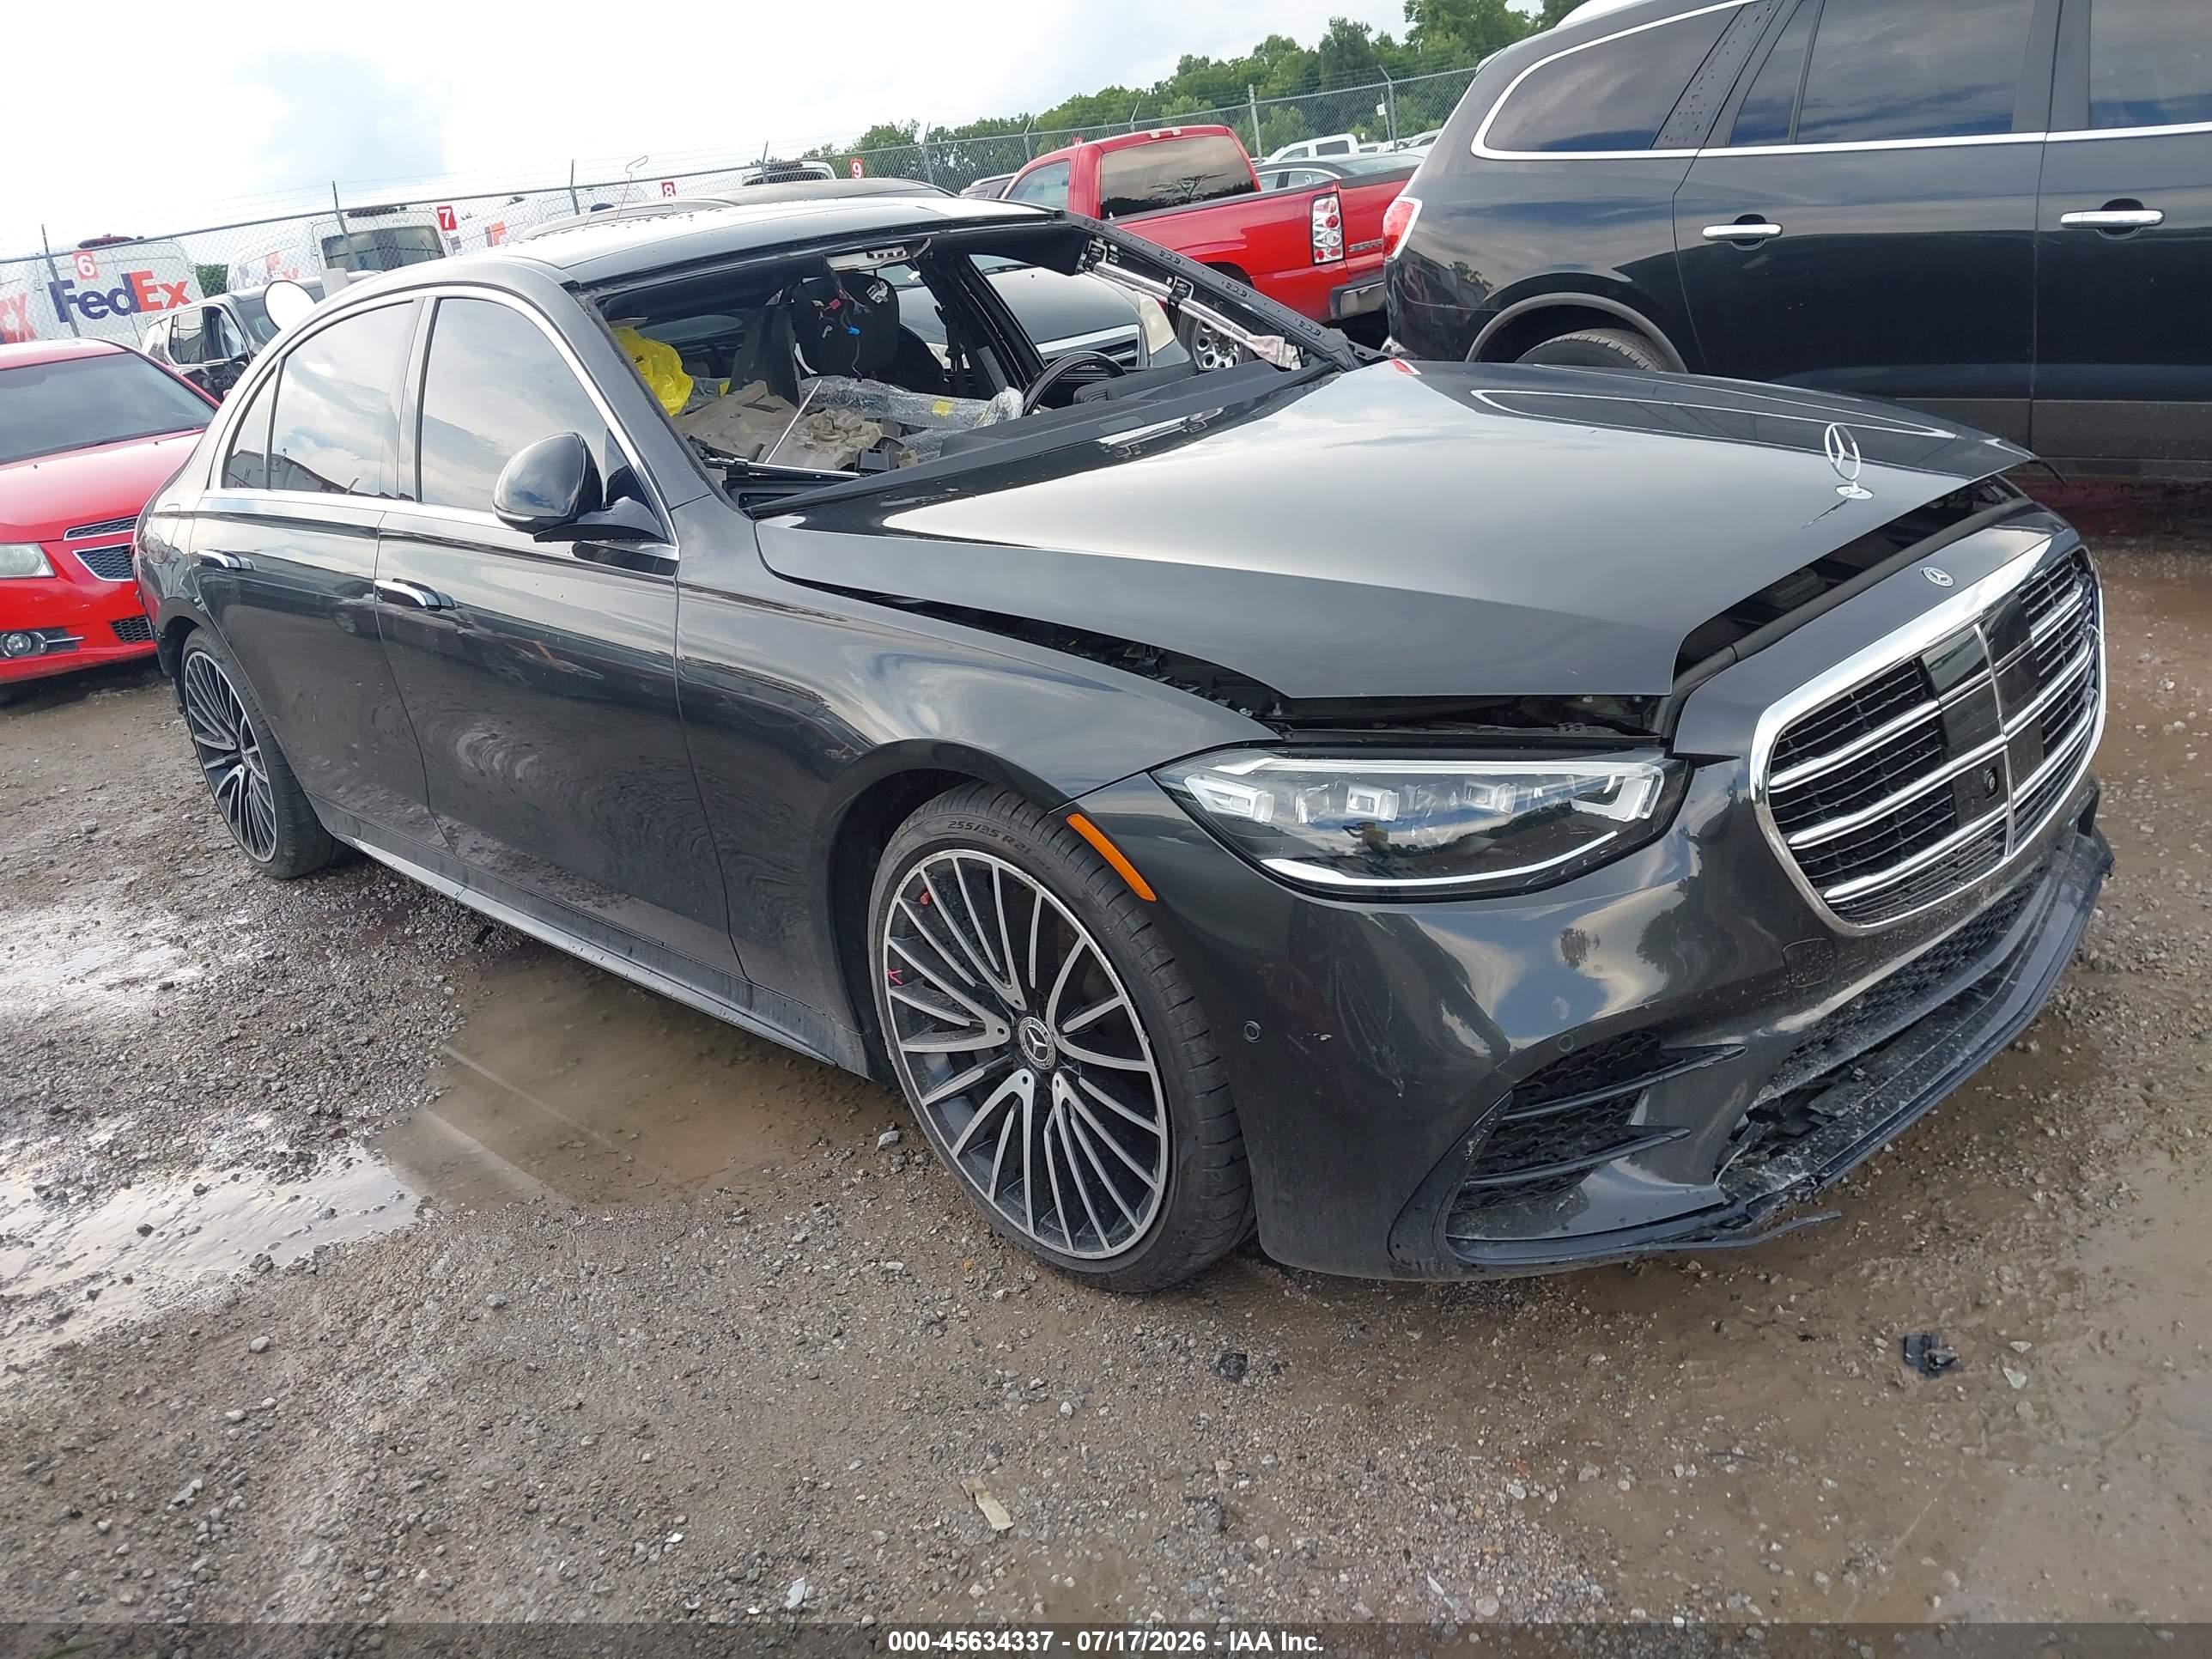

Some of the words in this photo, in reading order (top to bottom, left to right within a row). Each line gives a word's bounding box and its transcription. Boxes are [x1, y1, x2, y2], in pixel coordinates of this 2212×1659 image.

[853, 161, 862, 179] 9
[663, 184, 675, 198] 8
[439, 208, 452, 228] 7
[77, 255, 95, 276] 6
[47, 270, 192, 323] FedEx
[947, 820, 1001, 838] 255/35
